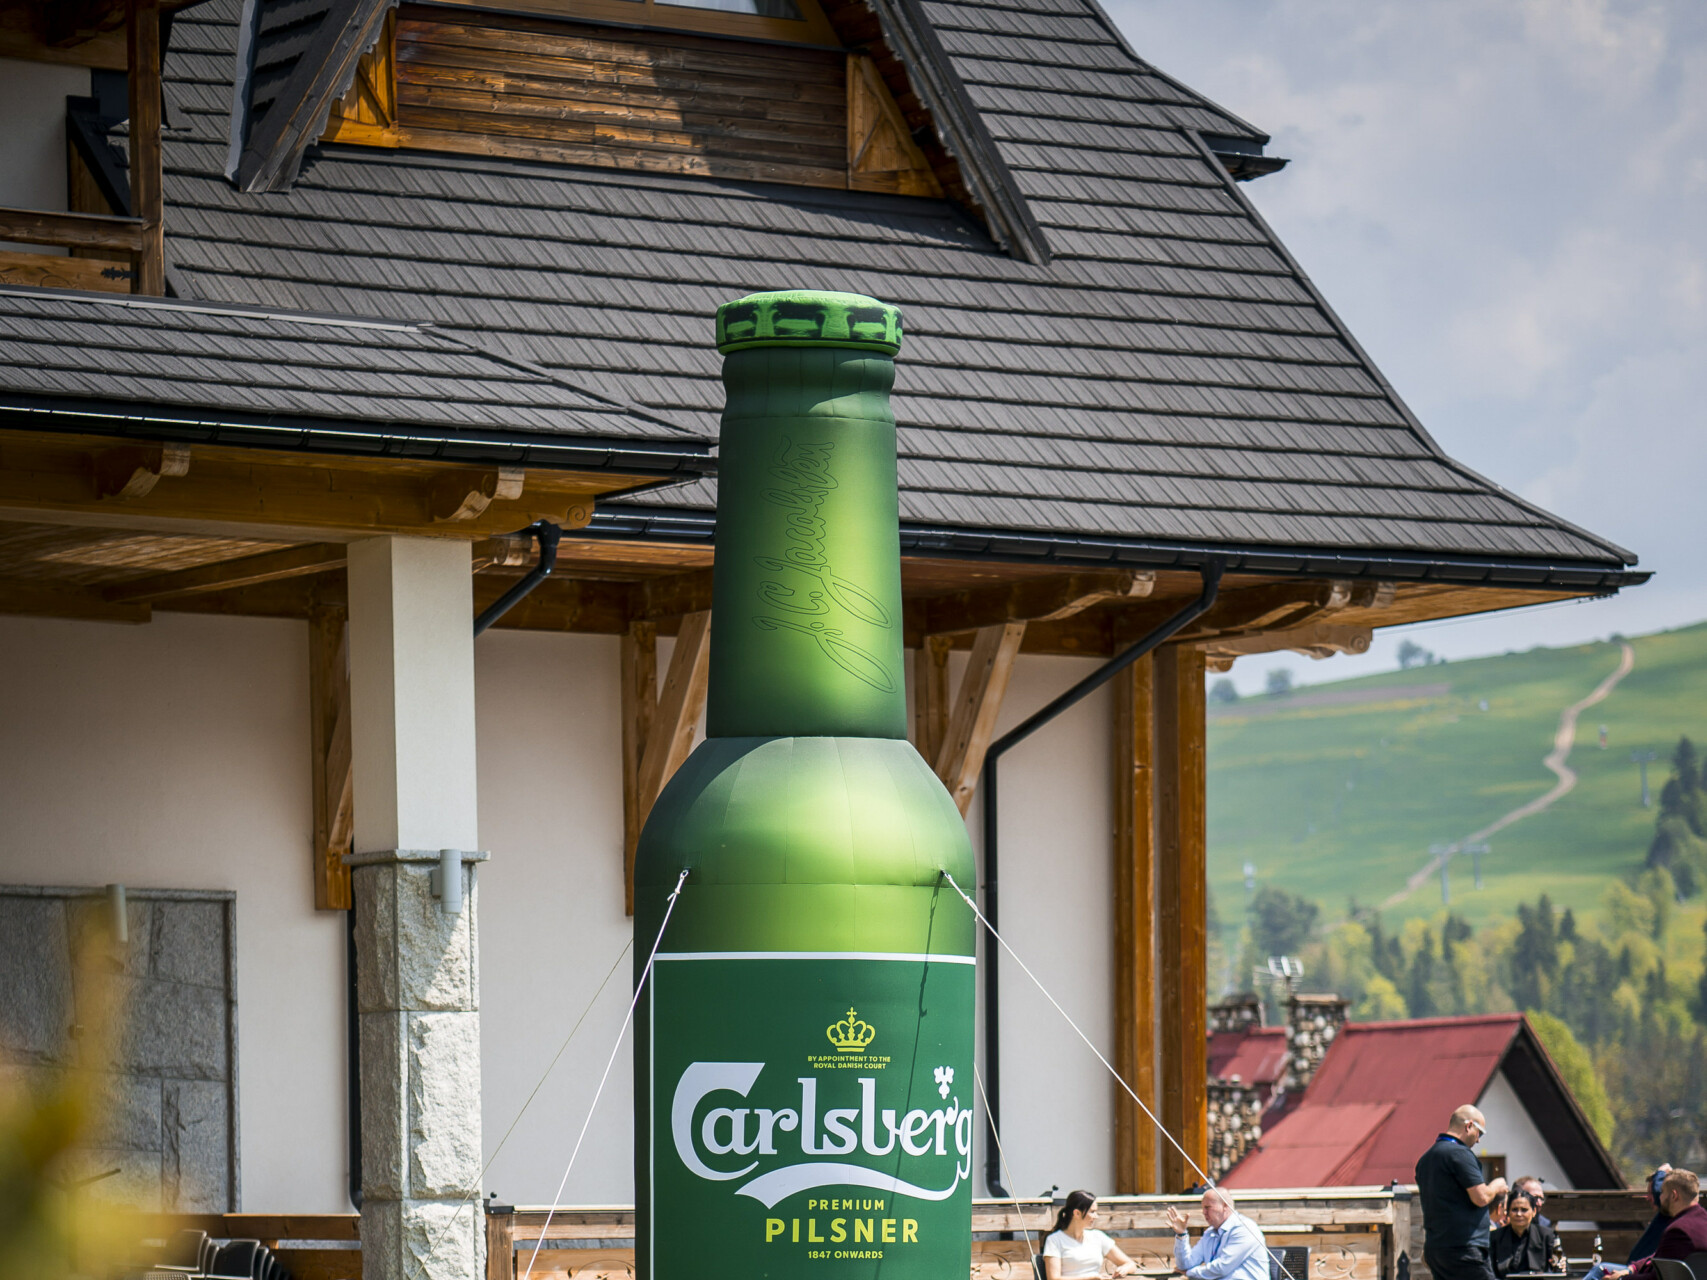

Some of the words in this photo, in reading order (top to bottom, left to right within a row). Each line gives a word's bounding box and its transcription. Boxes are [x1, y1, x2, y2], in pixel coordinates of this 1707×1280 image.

[671, 1061, 973, 1181] Carlsberg
[808, 1199, 885, 1211] PREMIUM
[765, 1218, 919, 1243] PILSNER
[807, 1250, 832, 1259] 1847
[834, 1250, 884, 1260] ONWARDS
